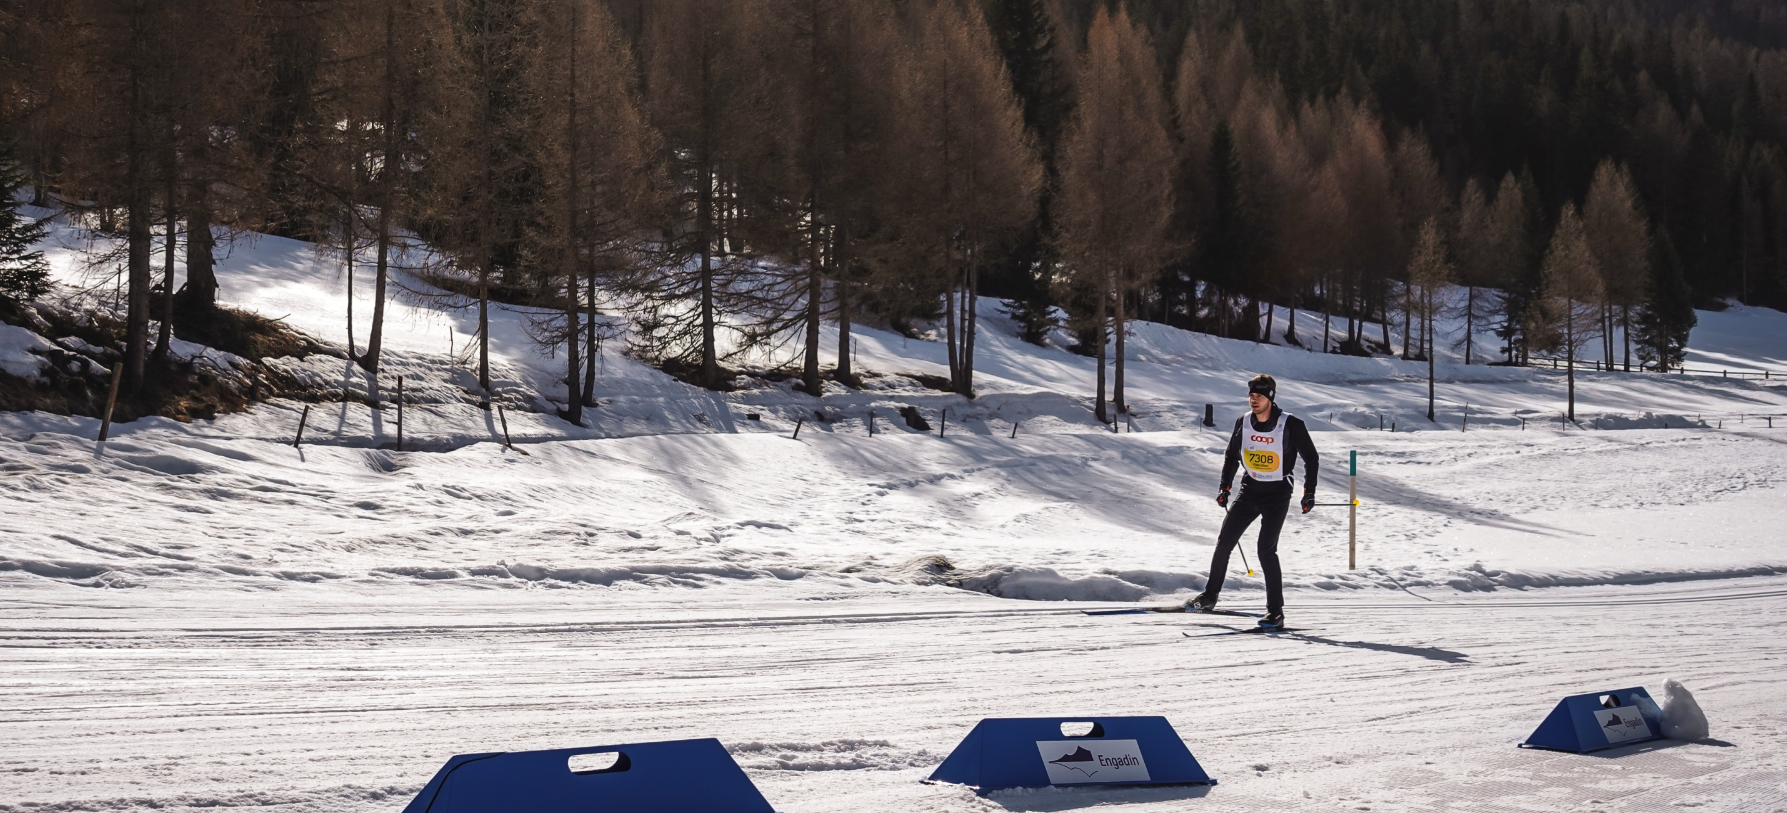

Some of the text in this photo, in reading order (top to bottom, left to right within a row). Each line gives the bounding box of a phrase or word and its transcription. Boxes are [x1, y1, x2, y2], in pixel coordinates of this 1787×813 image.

[1250, 435, 1274, 444] coop
[1249, 454, 1274, 464] 7308
[1098, 754, 1140, 769] Engadin
